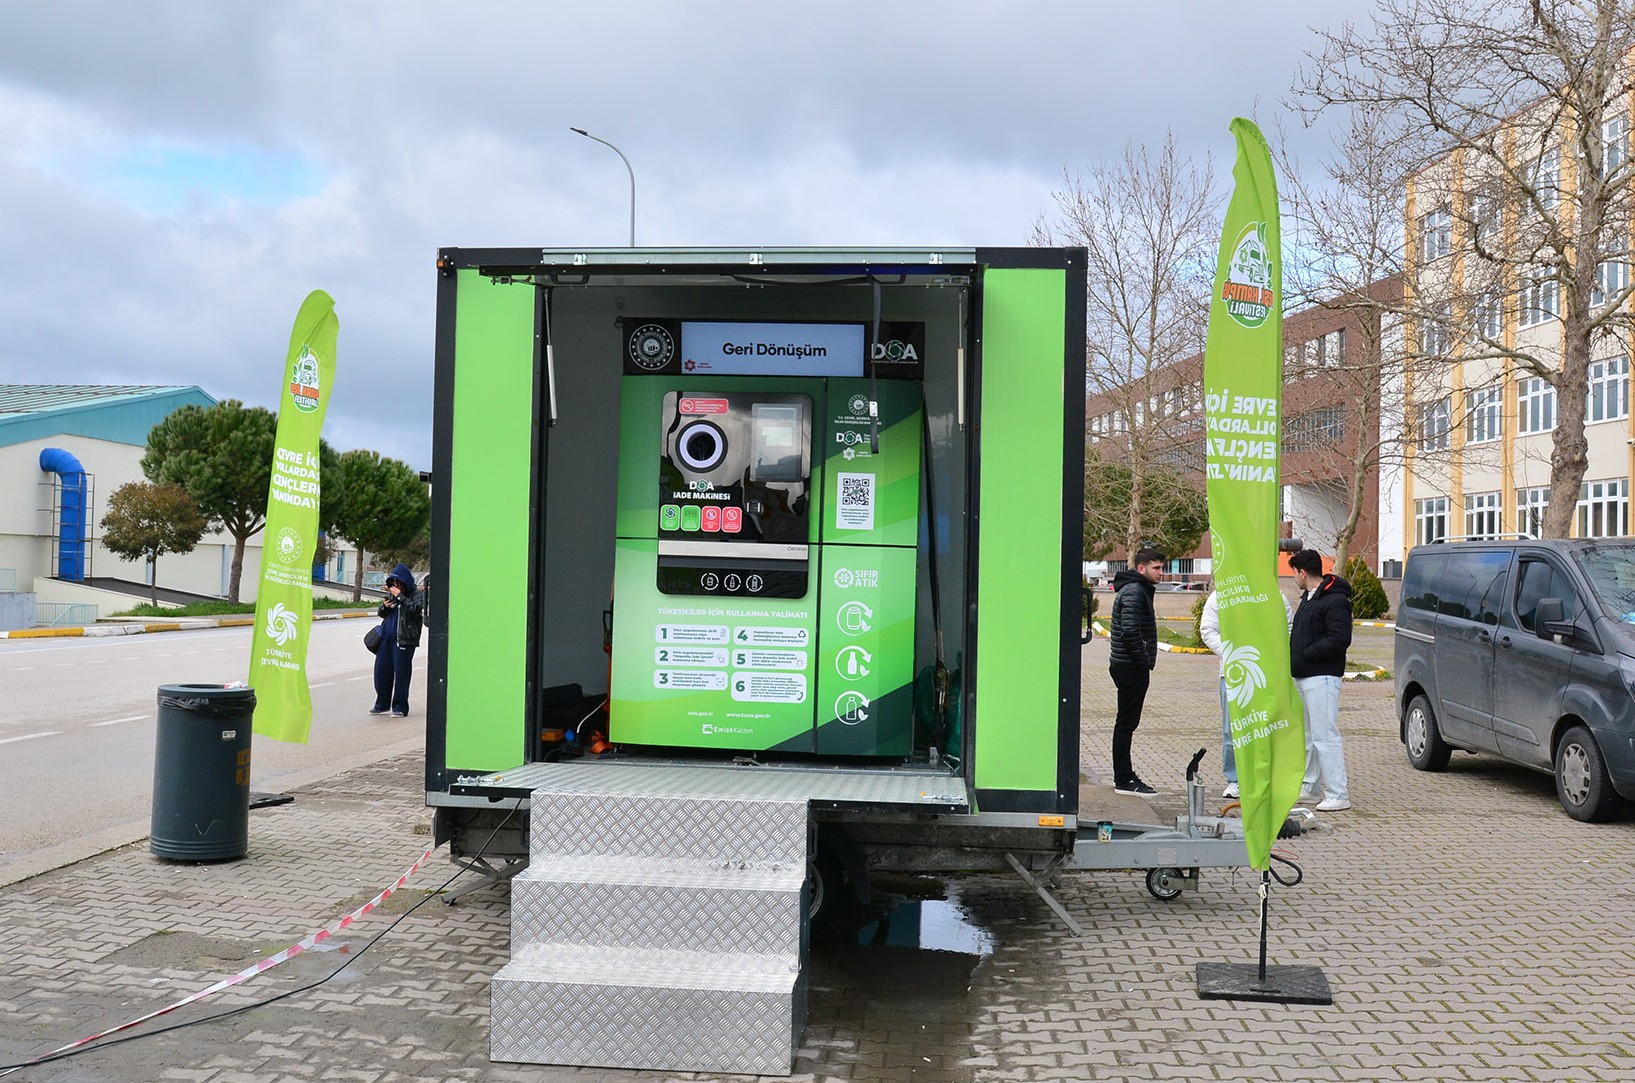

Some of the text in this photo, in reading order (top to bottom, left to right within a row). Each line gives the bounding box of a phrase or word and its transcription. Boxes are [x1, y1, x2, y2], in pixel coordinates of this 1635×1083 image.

[722, 342, 827, 360] Geri Dönüşüm
[871, 339, 918, 361] DOA
[836, 430, 864, 446] DOA
[689, 479, 715, 492] DOA
[855, 570, 878, 579] SIFIR
[855, 578, 878, 587] ATIK
[661, 628, 667, 639] 1
[737, 630, 748, 641] 4
[659, 650, 669, 661] 2
[737, 653, 746, 665] 5
[659, 673, 668, 684] 3
[735, 680, 745, 692] 6
[1230, 709, 1268, 733] TÜRKİYE
[1254, 719, 1289, 739] AJANSI
